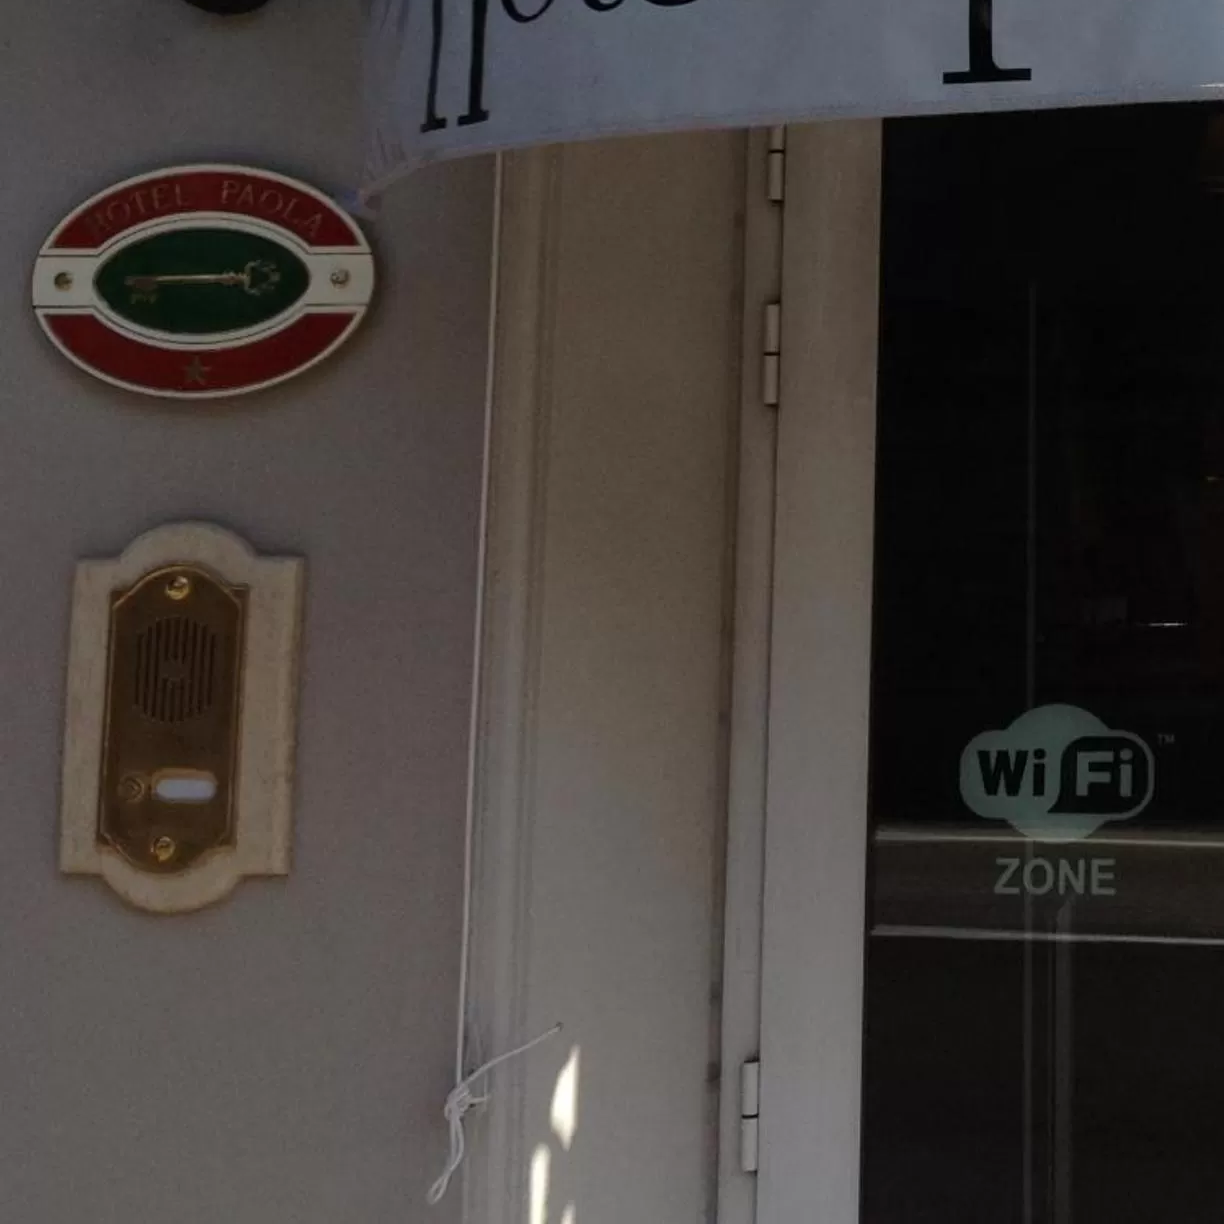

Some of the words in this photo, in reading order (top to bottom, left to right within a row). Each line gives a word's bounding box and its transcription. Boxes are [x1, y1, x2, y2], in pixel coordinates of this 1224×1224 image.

[86, 183, 190, 239] HOTEL
[221, 180, 323, 238] PAOLA
[993, 857, 1117, 896] ZONE
